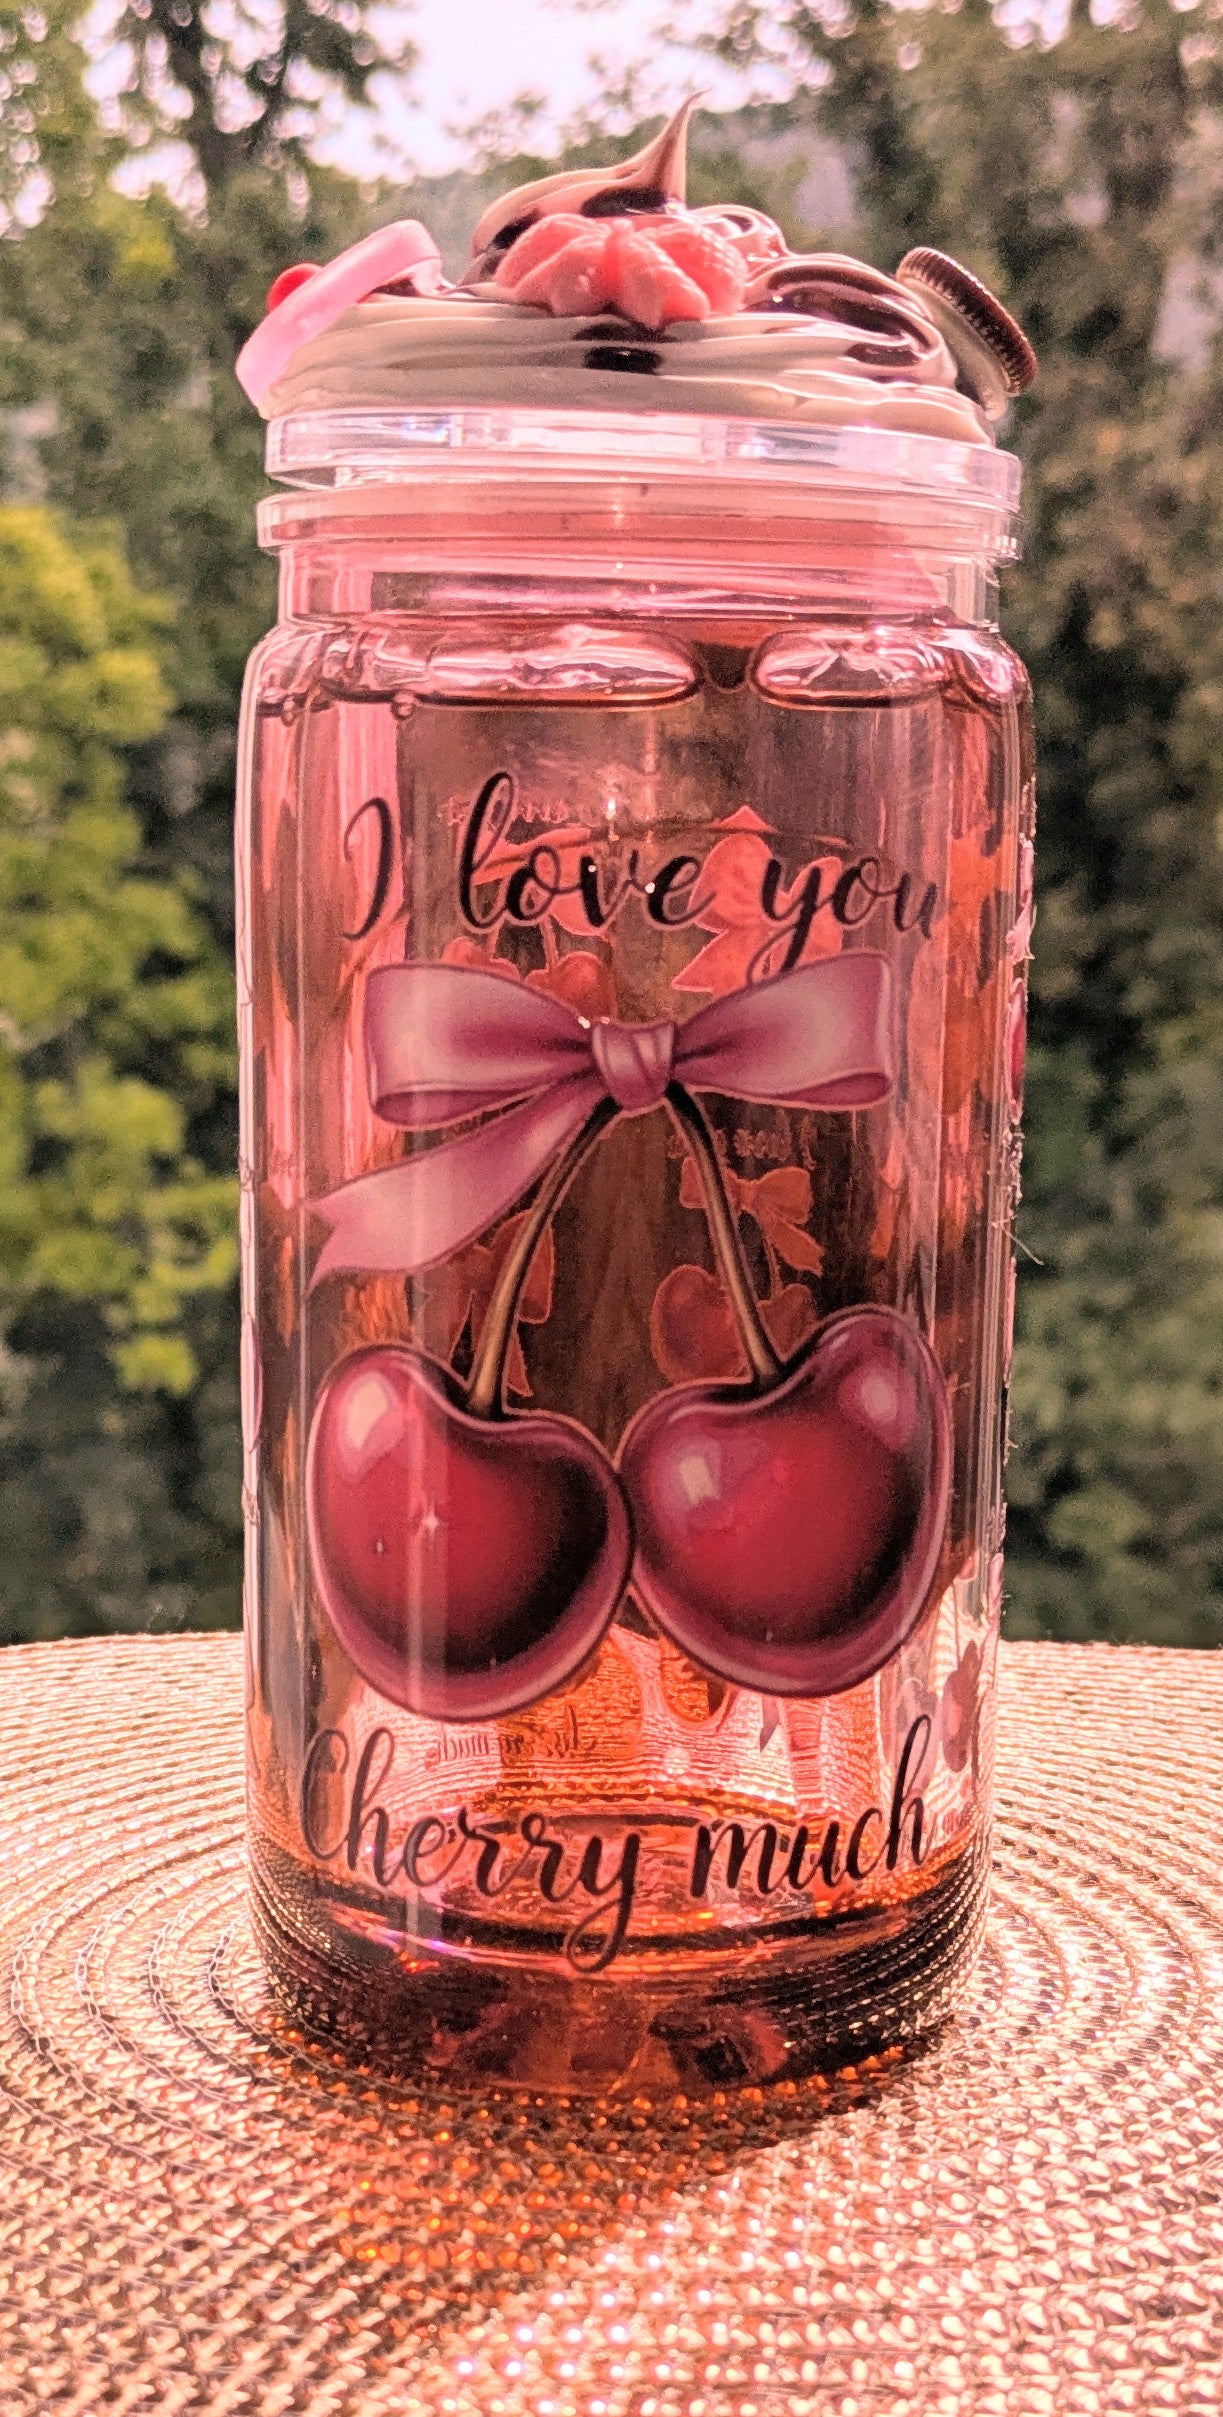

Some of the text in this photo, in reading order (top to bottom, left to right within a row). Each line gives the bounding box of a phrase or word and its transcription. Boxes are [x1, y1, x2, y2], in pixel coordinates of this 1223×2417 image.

[342, 771, 938, 987] I love you
[300, 1714, 934, 1972] Cherry much
